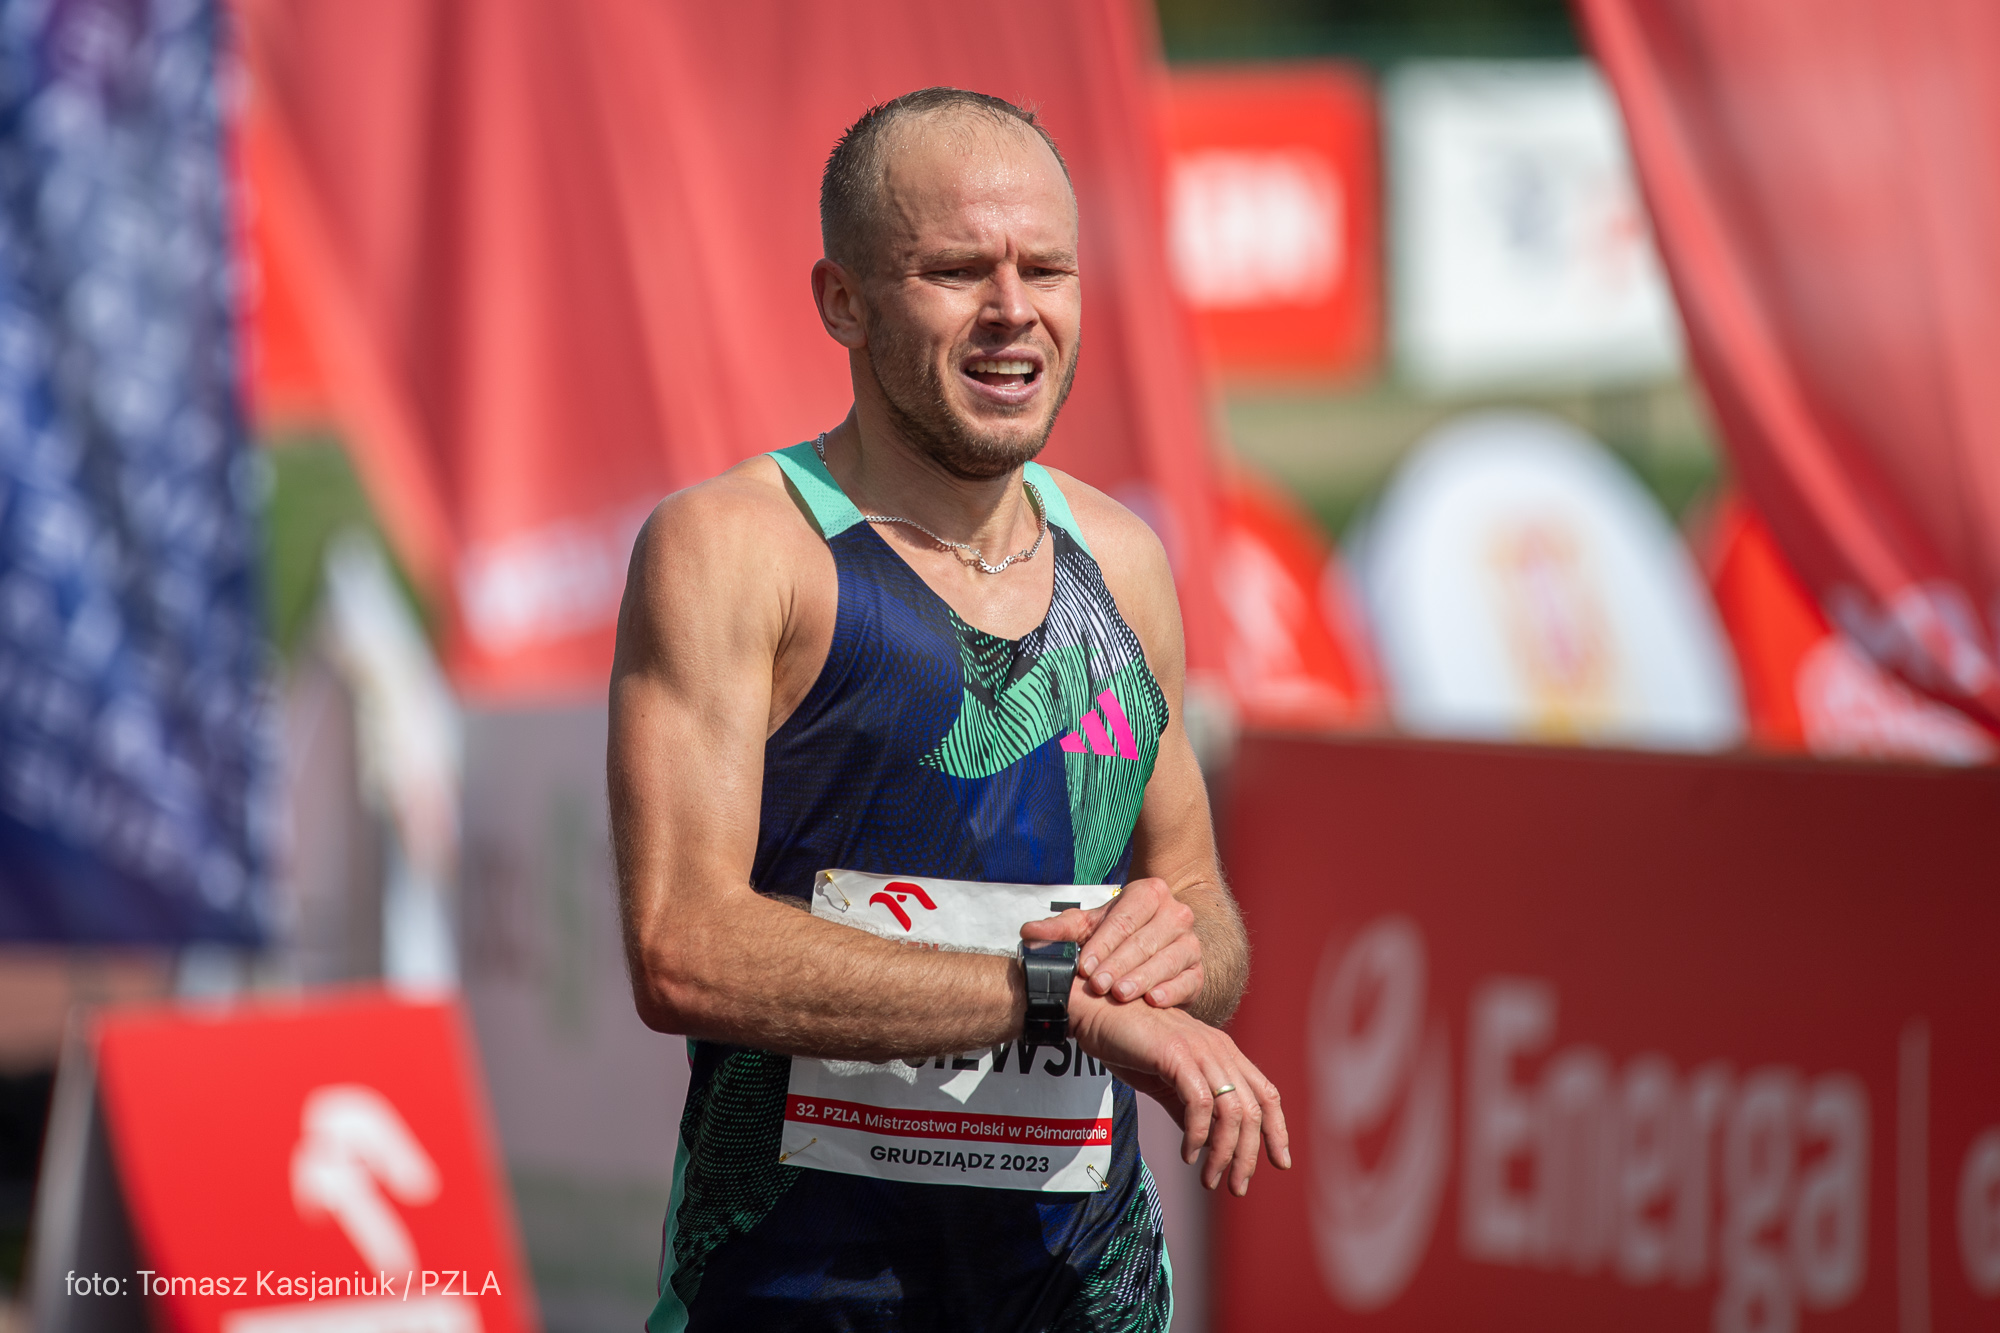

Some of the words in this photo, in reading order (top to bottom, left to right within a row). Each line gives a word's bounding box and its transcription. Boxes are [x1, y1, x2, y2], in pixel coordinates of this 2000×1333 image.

[795, 1102, 819, 1118] 32.
[823, 1106, 861, 1124] PZLA
[865, 1113, 957, 1134] Mistrzostwa
[961, 1121, 1005, 1137] Polski
[1008, 1126, 1022, 1138] w
[1025, 1124, 1108, 1140] Półmaratonie
[870, 1145, 996, 1172] GRUDZIĄDZ
[1000, 1153, 1050, 1173] 2023
